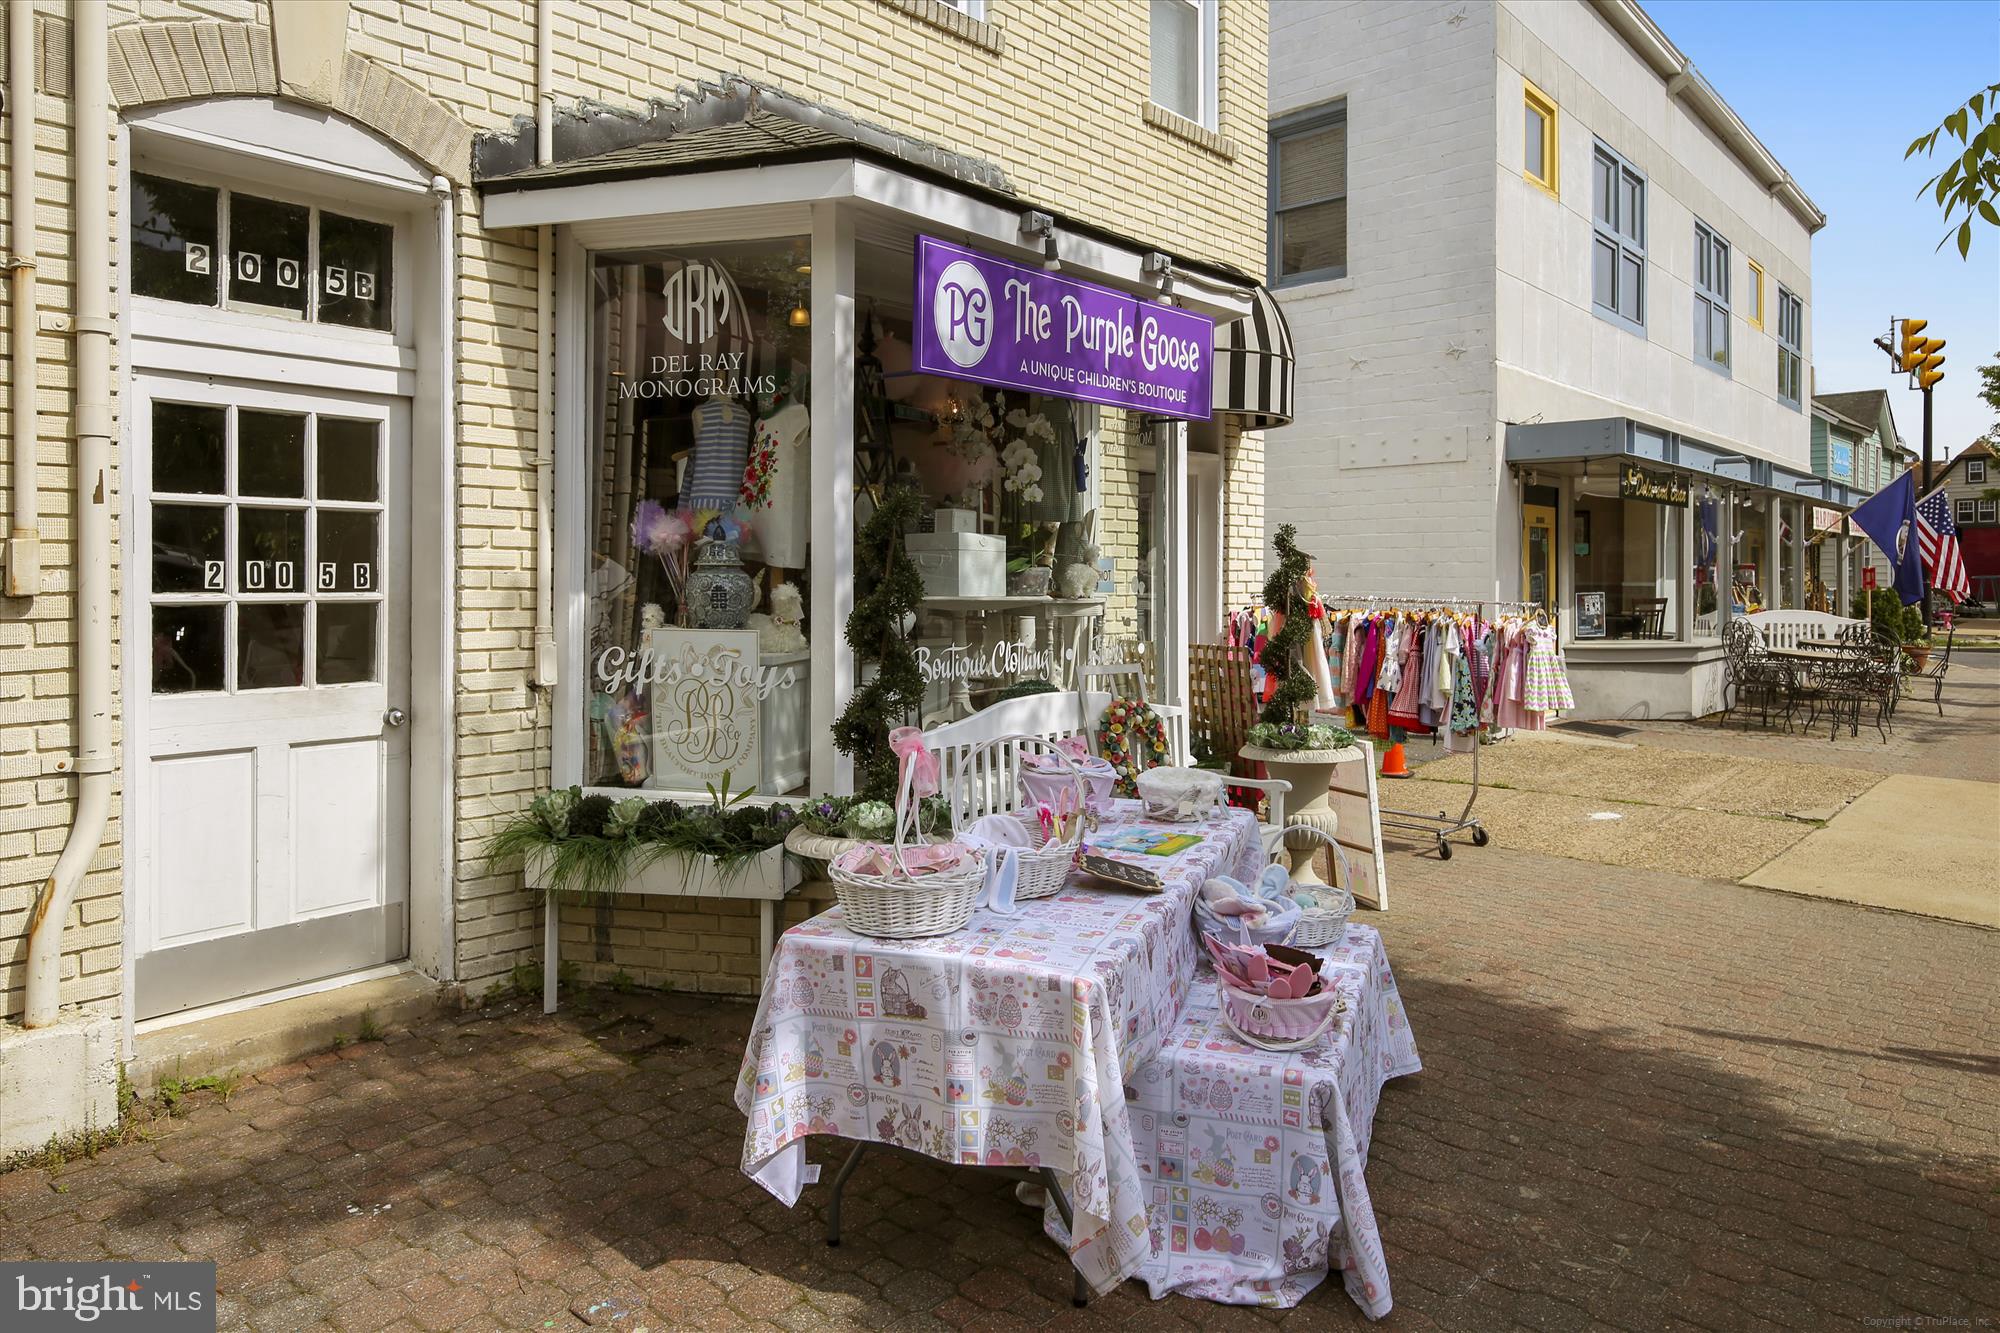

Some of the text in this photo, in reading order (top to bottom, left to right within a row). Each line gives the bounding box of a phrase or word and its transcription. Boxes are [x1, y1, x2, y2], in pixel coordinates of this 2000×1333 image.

[942, 281, 987, 347] PG
[1004, 278, 1200, 373] The Purple Goose
[618, 375, 776, 400] MONOGRAMS
[652, 352, 744, 374] DEL RAY
[1020, 359, 1187, 404] A UNIQUE CHILDREN'S BOUTIQUE
[597, 646, 796, 700] Gifts Toys
[912, 643, 987, 689] Boutique
[991, 639, 1049, 681] Clothing
